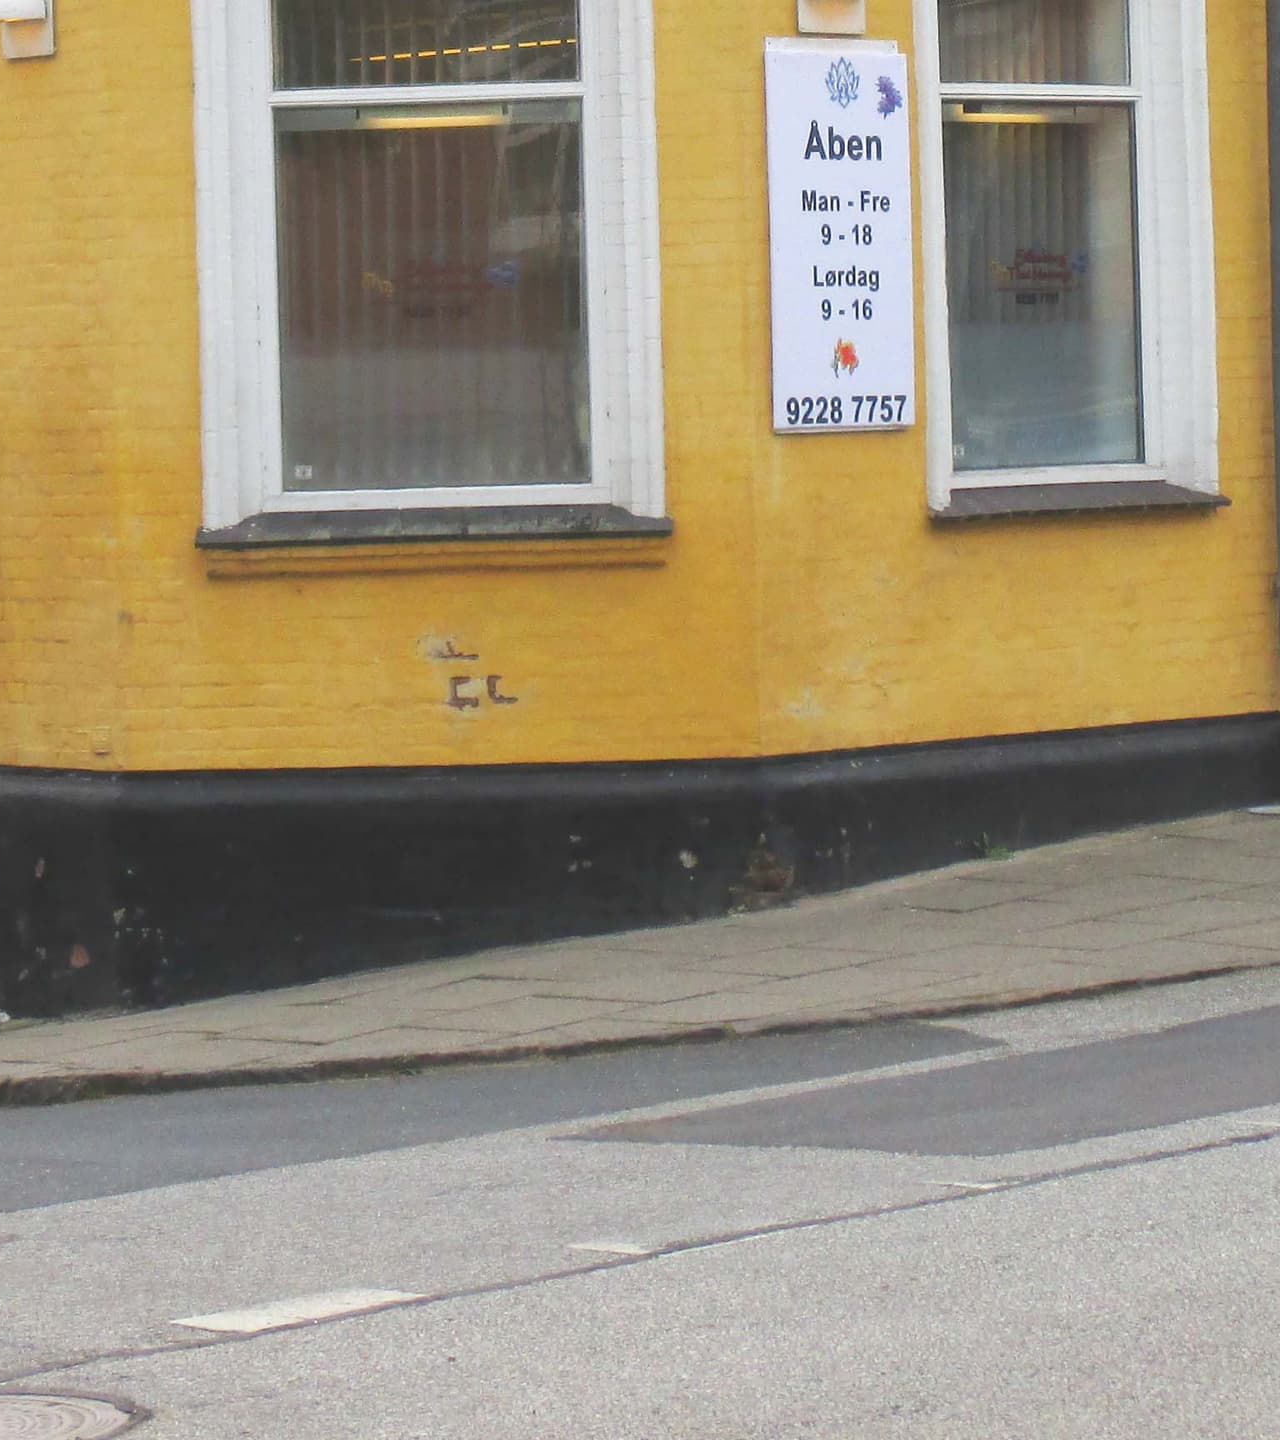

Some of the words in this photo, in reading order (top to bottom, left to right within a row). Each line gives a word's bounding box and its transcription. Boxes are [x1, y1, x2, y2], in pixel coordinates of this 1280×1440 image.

[803, 119, 883, 161] Åben
[801, 190, 841, 212] Man
[860, 190, 891, 213] Fre
[820, 223, 832, 246] 9
[851, 223, 873, 246] 18
[812, 265, 880, 292] Lørdag
[820, 298, 832, 321] 9
[851, 298, 873, 321] 16
[785, 396, 843, 426] 9228
[851, 394, 907, 423] 7757
